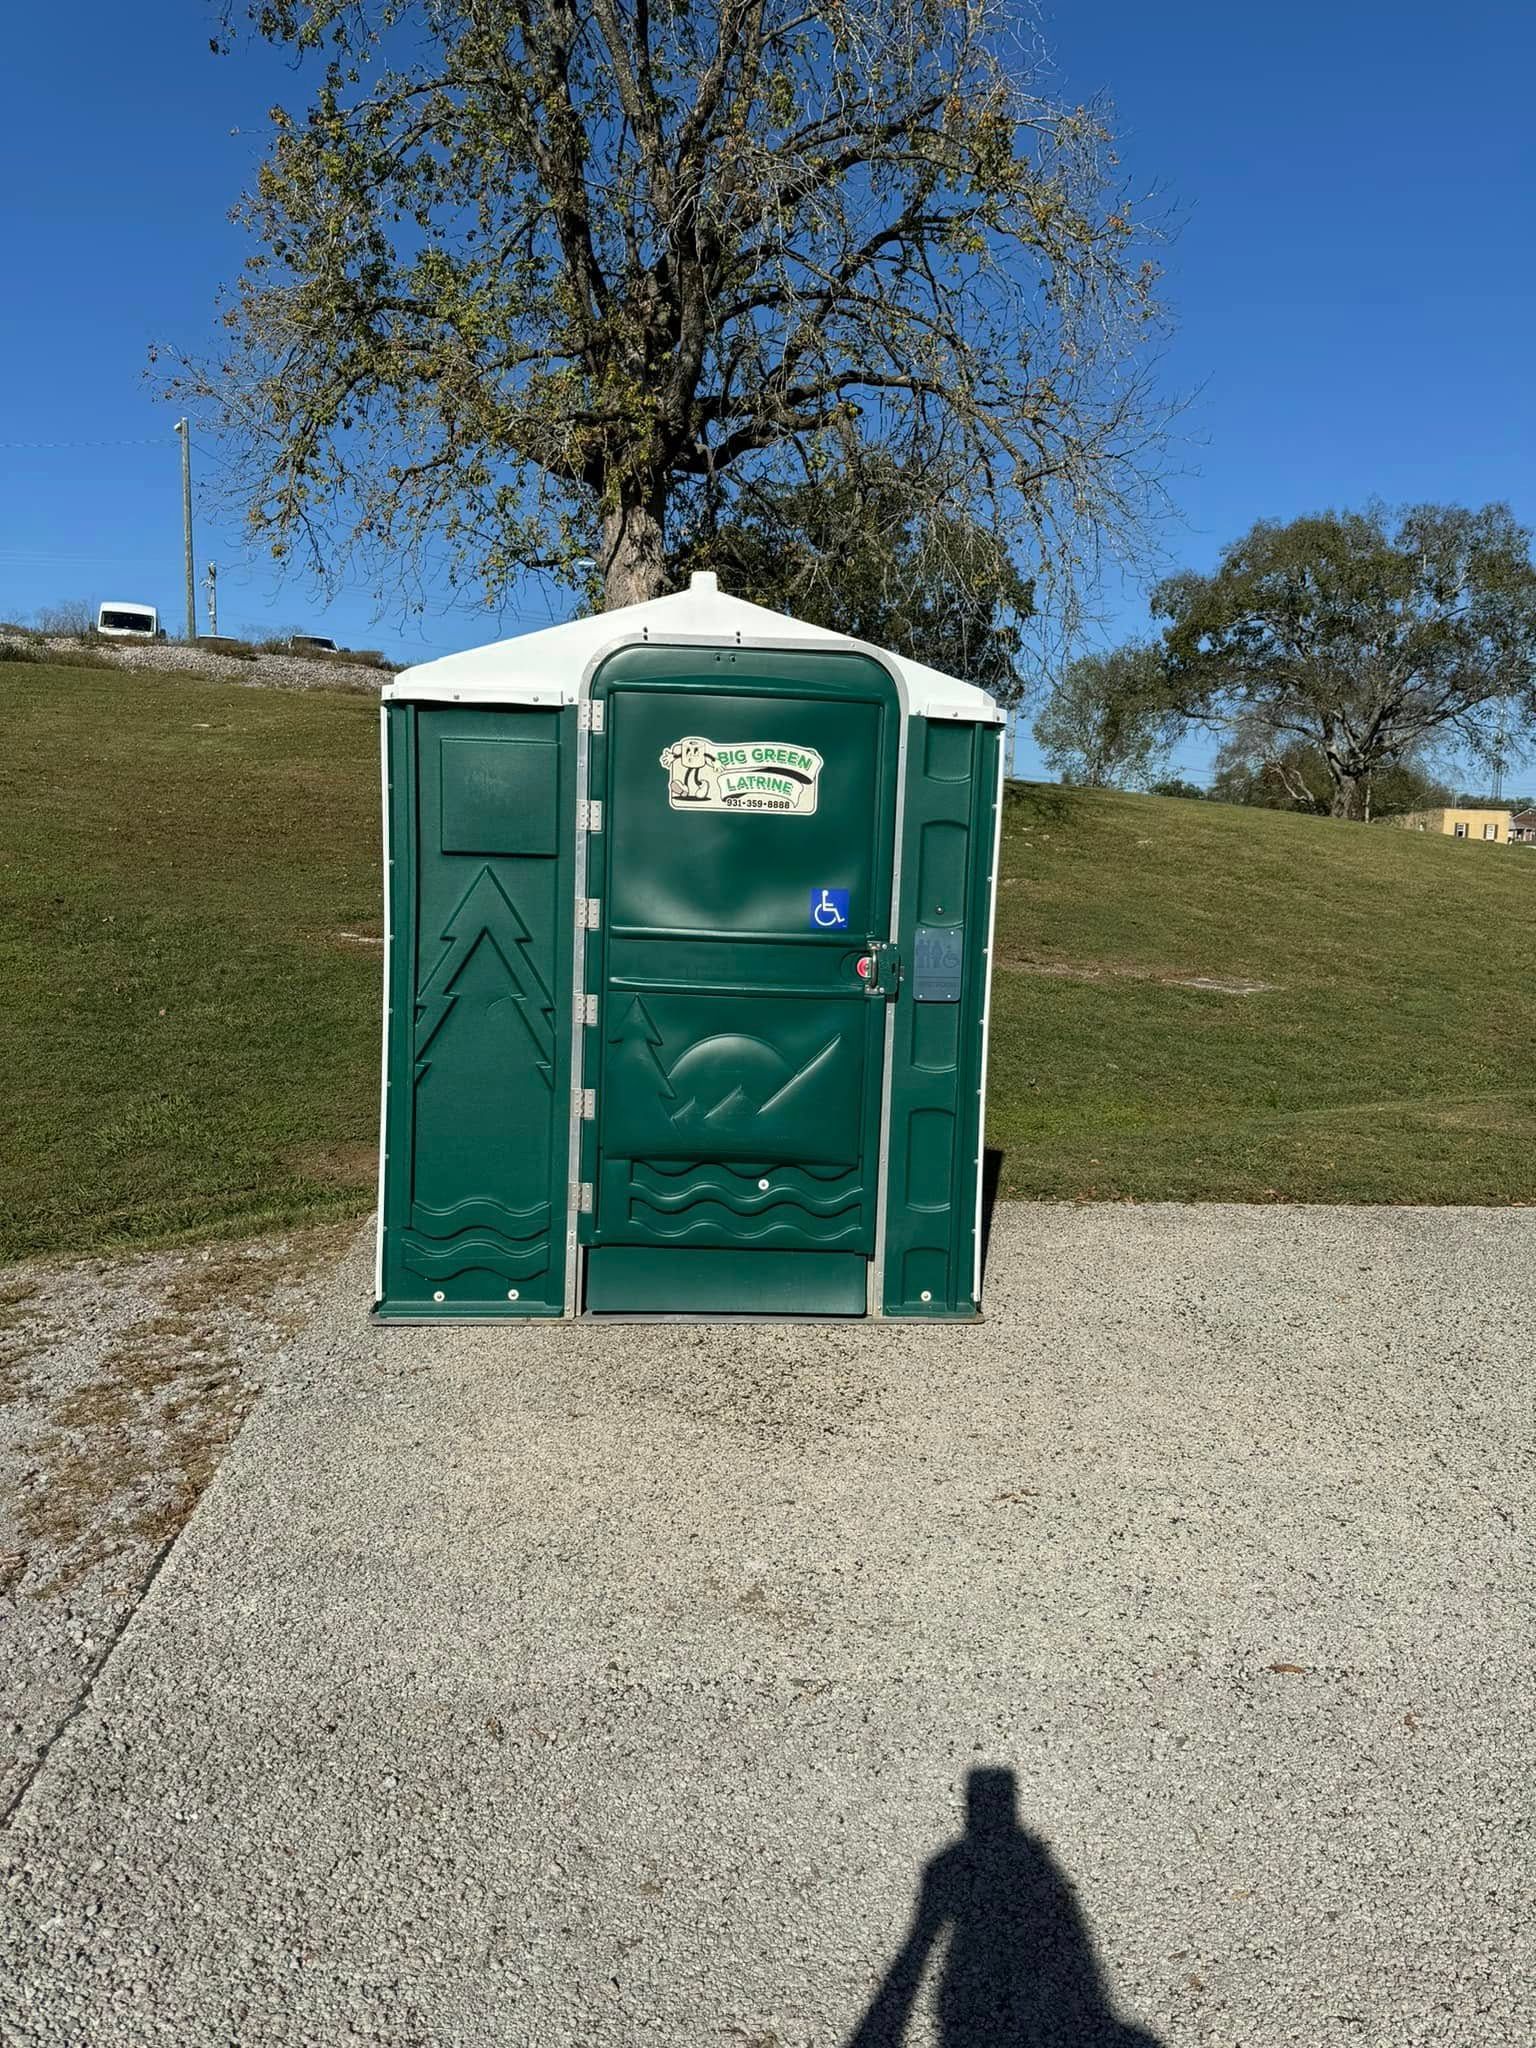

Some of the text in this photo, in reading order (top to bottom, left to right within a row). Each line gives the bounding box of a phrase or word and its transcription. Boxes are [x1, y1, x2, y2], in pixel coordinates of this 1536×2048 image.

[717, 748, 812, 770] BIG GREEN
[726, 776, 793, 795] LATRINE
